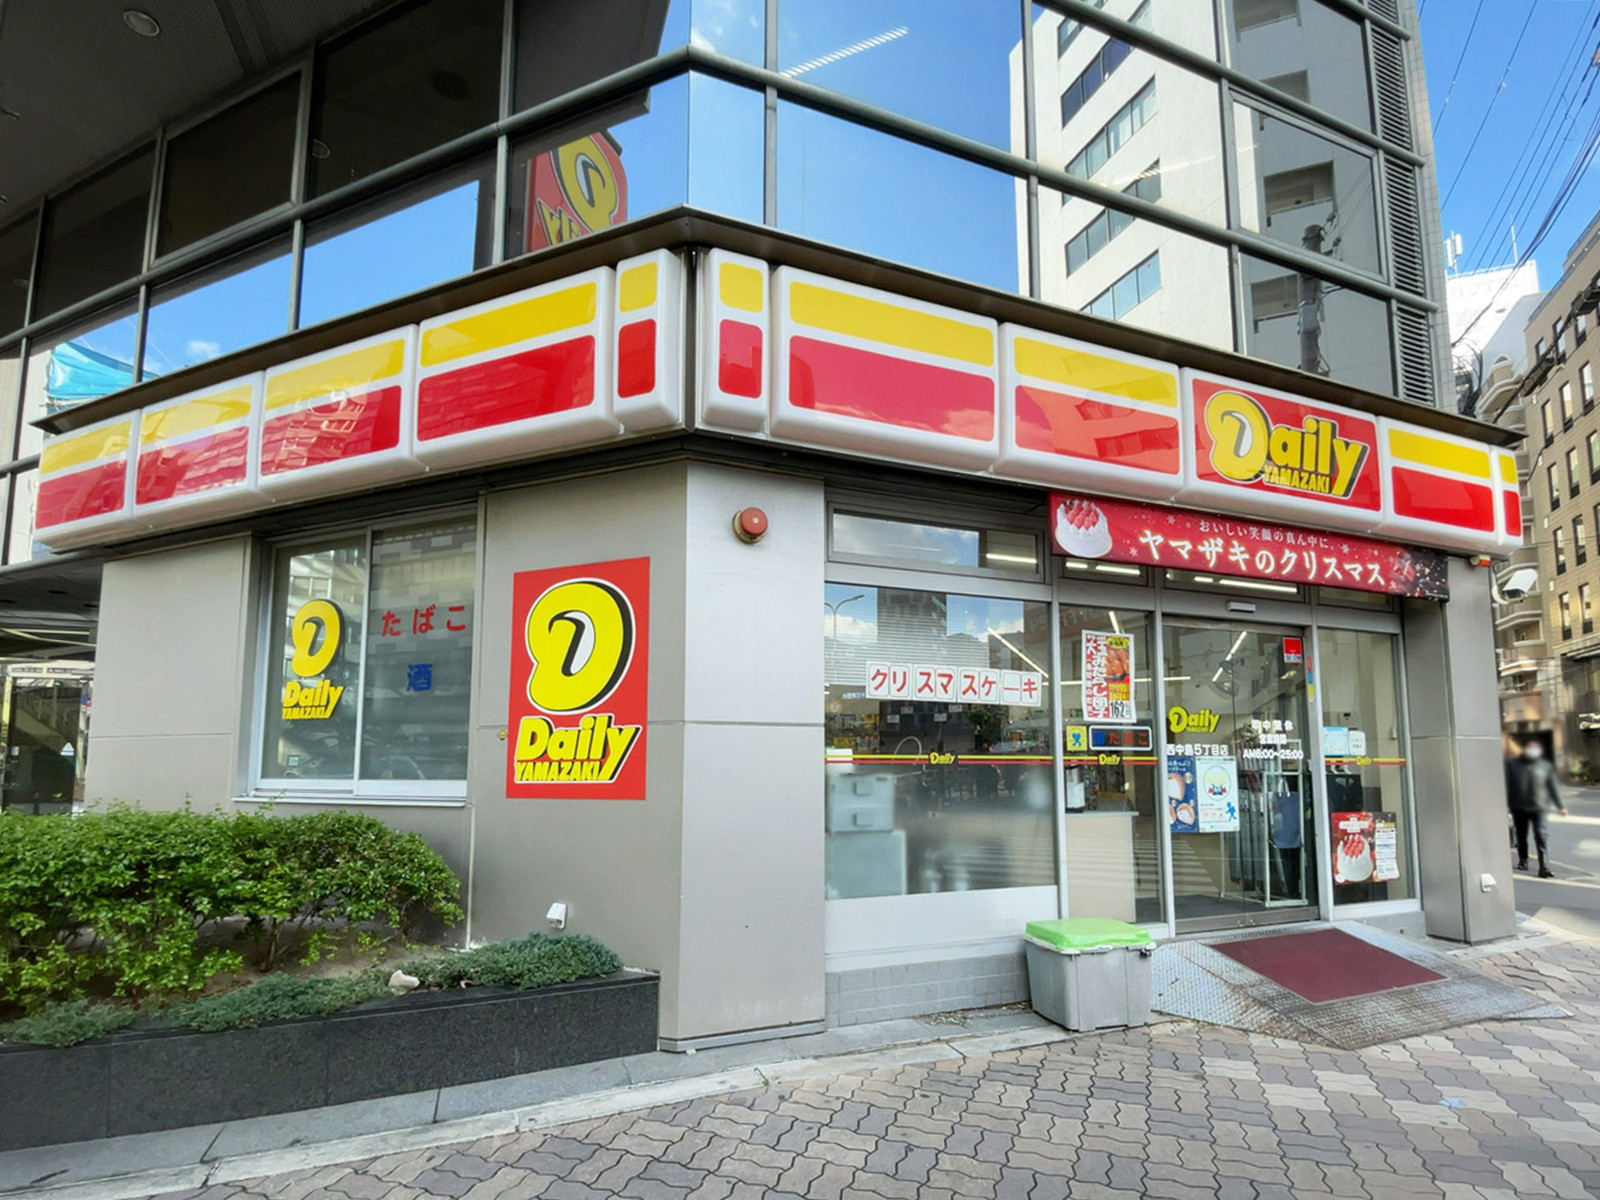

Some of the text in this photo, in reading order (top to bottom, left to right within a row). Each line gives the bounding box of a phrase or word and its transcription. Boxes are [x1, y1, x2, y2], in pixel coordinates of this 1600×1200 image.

[1205, 390, 1369, 498] Daily
[1264, 465, 1331, 494] YAMAZAKI
[1139, 529, 1386, 586] ヤマザキのクリスマス
[381, 604, 466, 637] たばこ
[406, 663, 433, 692] 酒
[871, 669, 1038, 699] クリスマスケーキ
[283, 680, 344, 719] Daily
[1110, 701, 1125, 718] 162
[1169, 706, 1221, 733] Daily
[515, 715, 640, 781] Daily
[929, 752, 956, 765] Daily
[515, 760, 600, 781] YAMAZAKI
